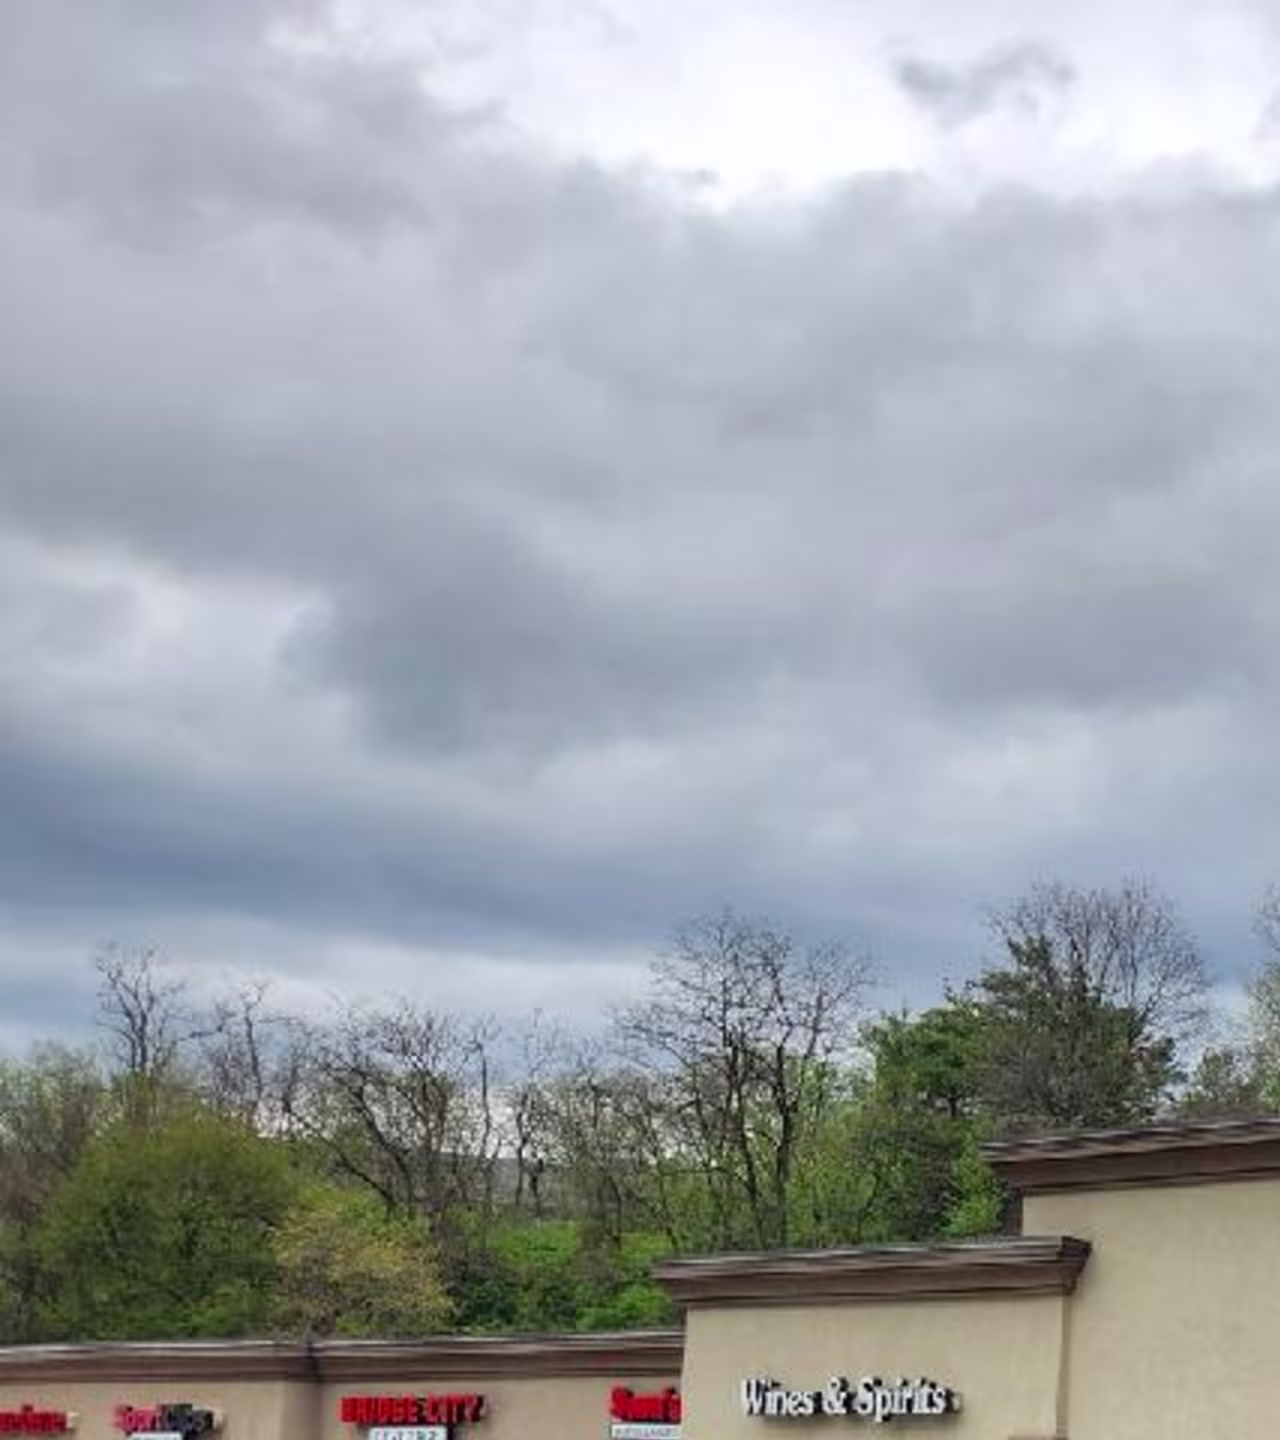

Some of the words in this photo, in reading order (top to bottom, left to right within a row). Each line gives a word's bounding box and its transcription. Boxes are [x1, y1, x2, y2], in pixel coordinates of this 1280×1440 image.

[741, 1377, 815, 1416] Wines
[821, 1375, 848, 1415] &
[855, 1375, 947, 1424] Spirits
